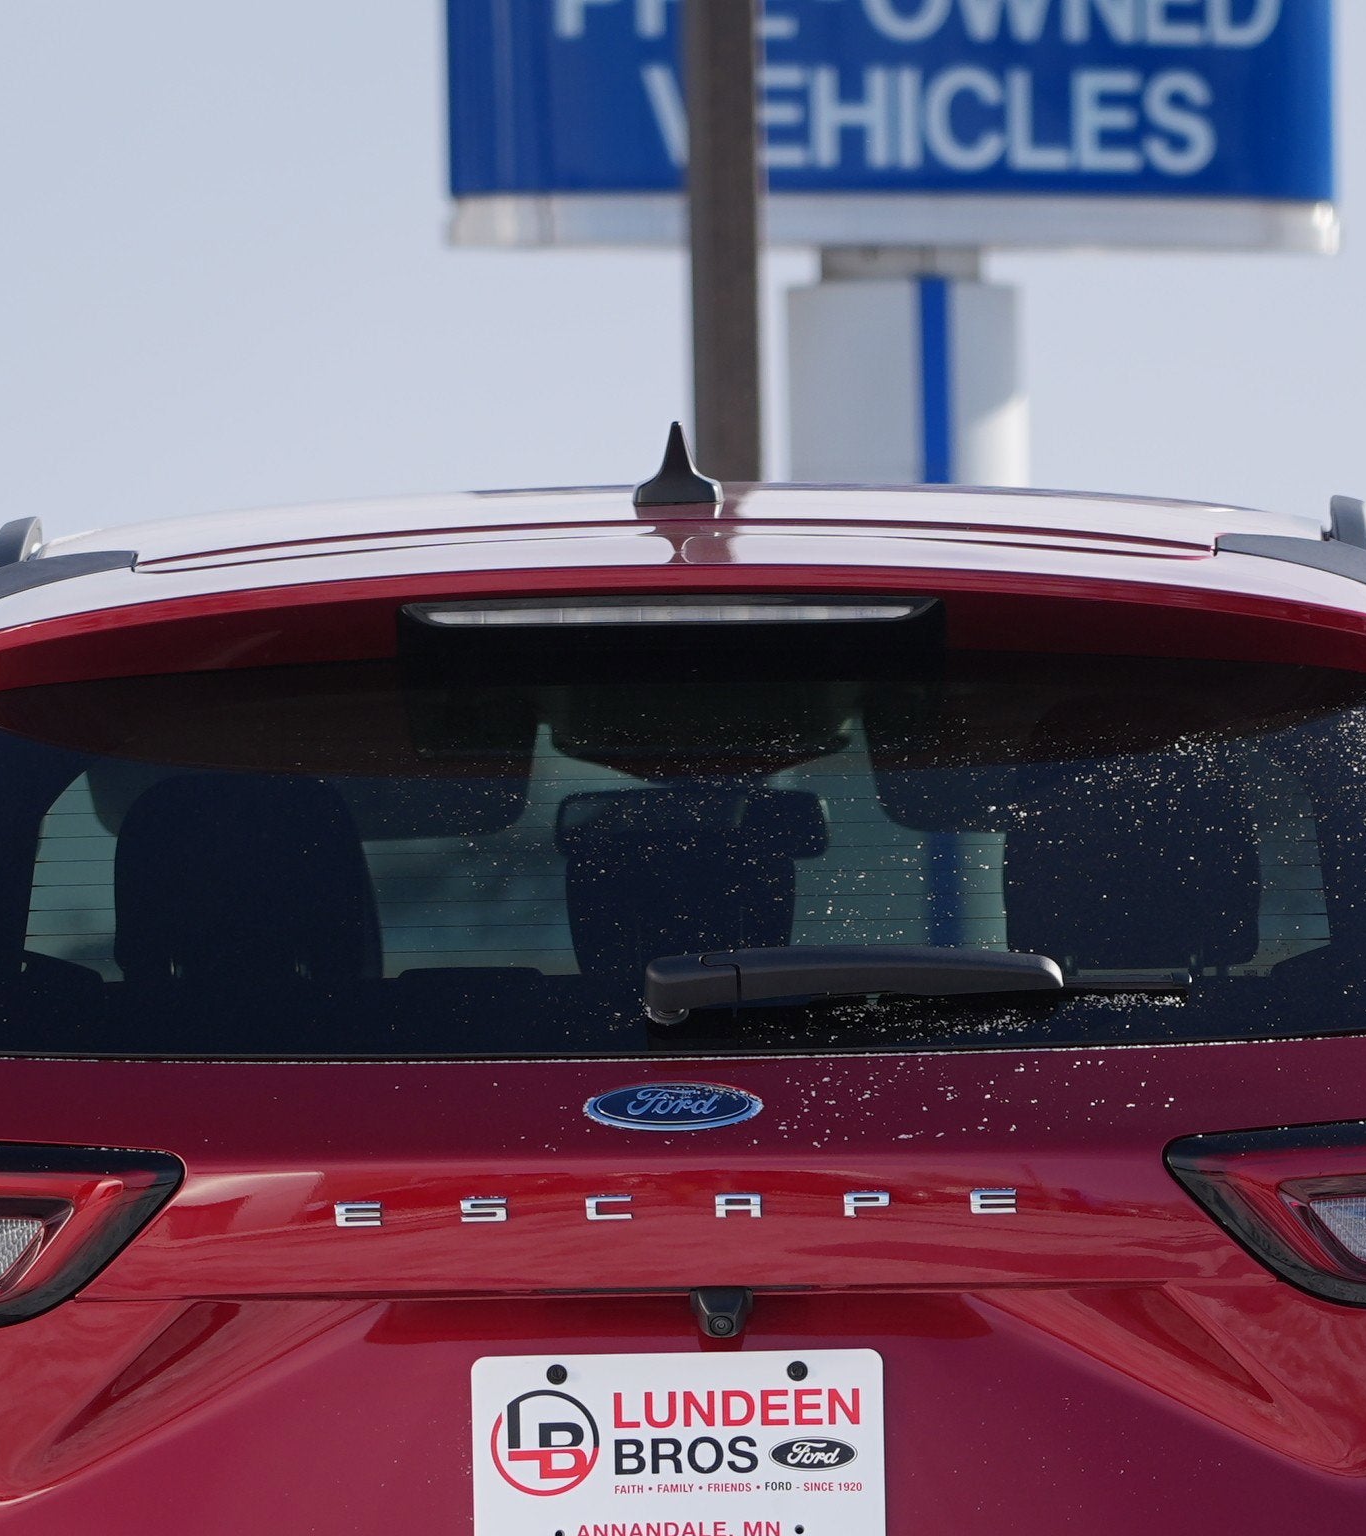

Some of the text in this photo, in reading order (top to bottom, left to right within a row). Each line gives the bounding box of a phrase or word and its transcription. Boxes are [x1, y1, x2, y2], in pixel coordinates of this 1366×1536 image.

[626, 1087, 721, 1116] Ford
[335, 1187, 1018, 1227] ESCAPE
[613, 1388, 860, 1429] LUNDEEN
[614, 1435, 759, 1476] BROS
[786, 1440, 840, 1467] Ford
[614, 1481, 863, 1494] FAITH FAMILY FRIENDS FORD SINCE 1920
